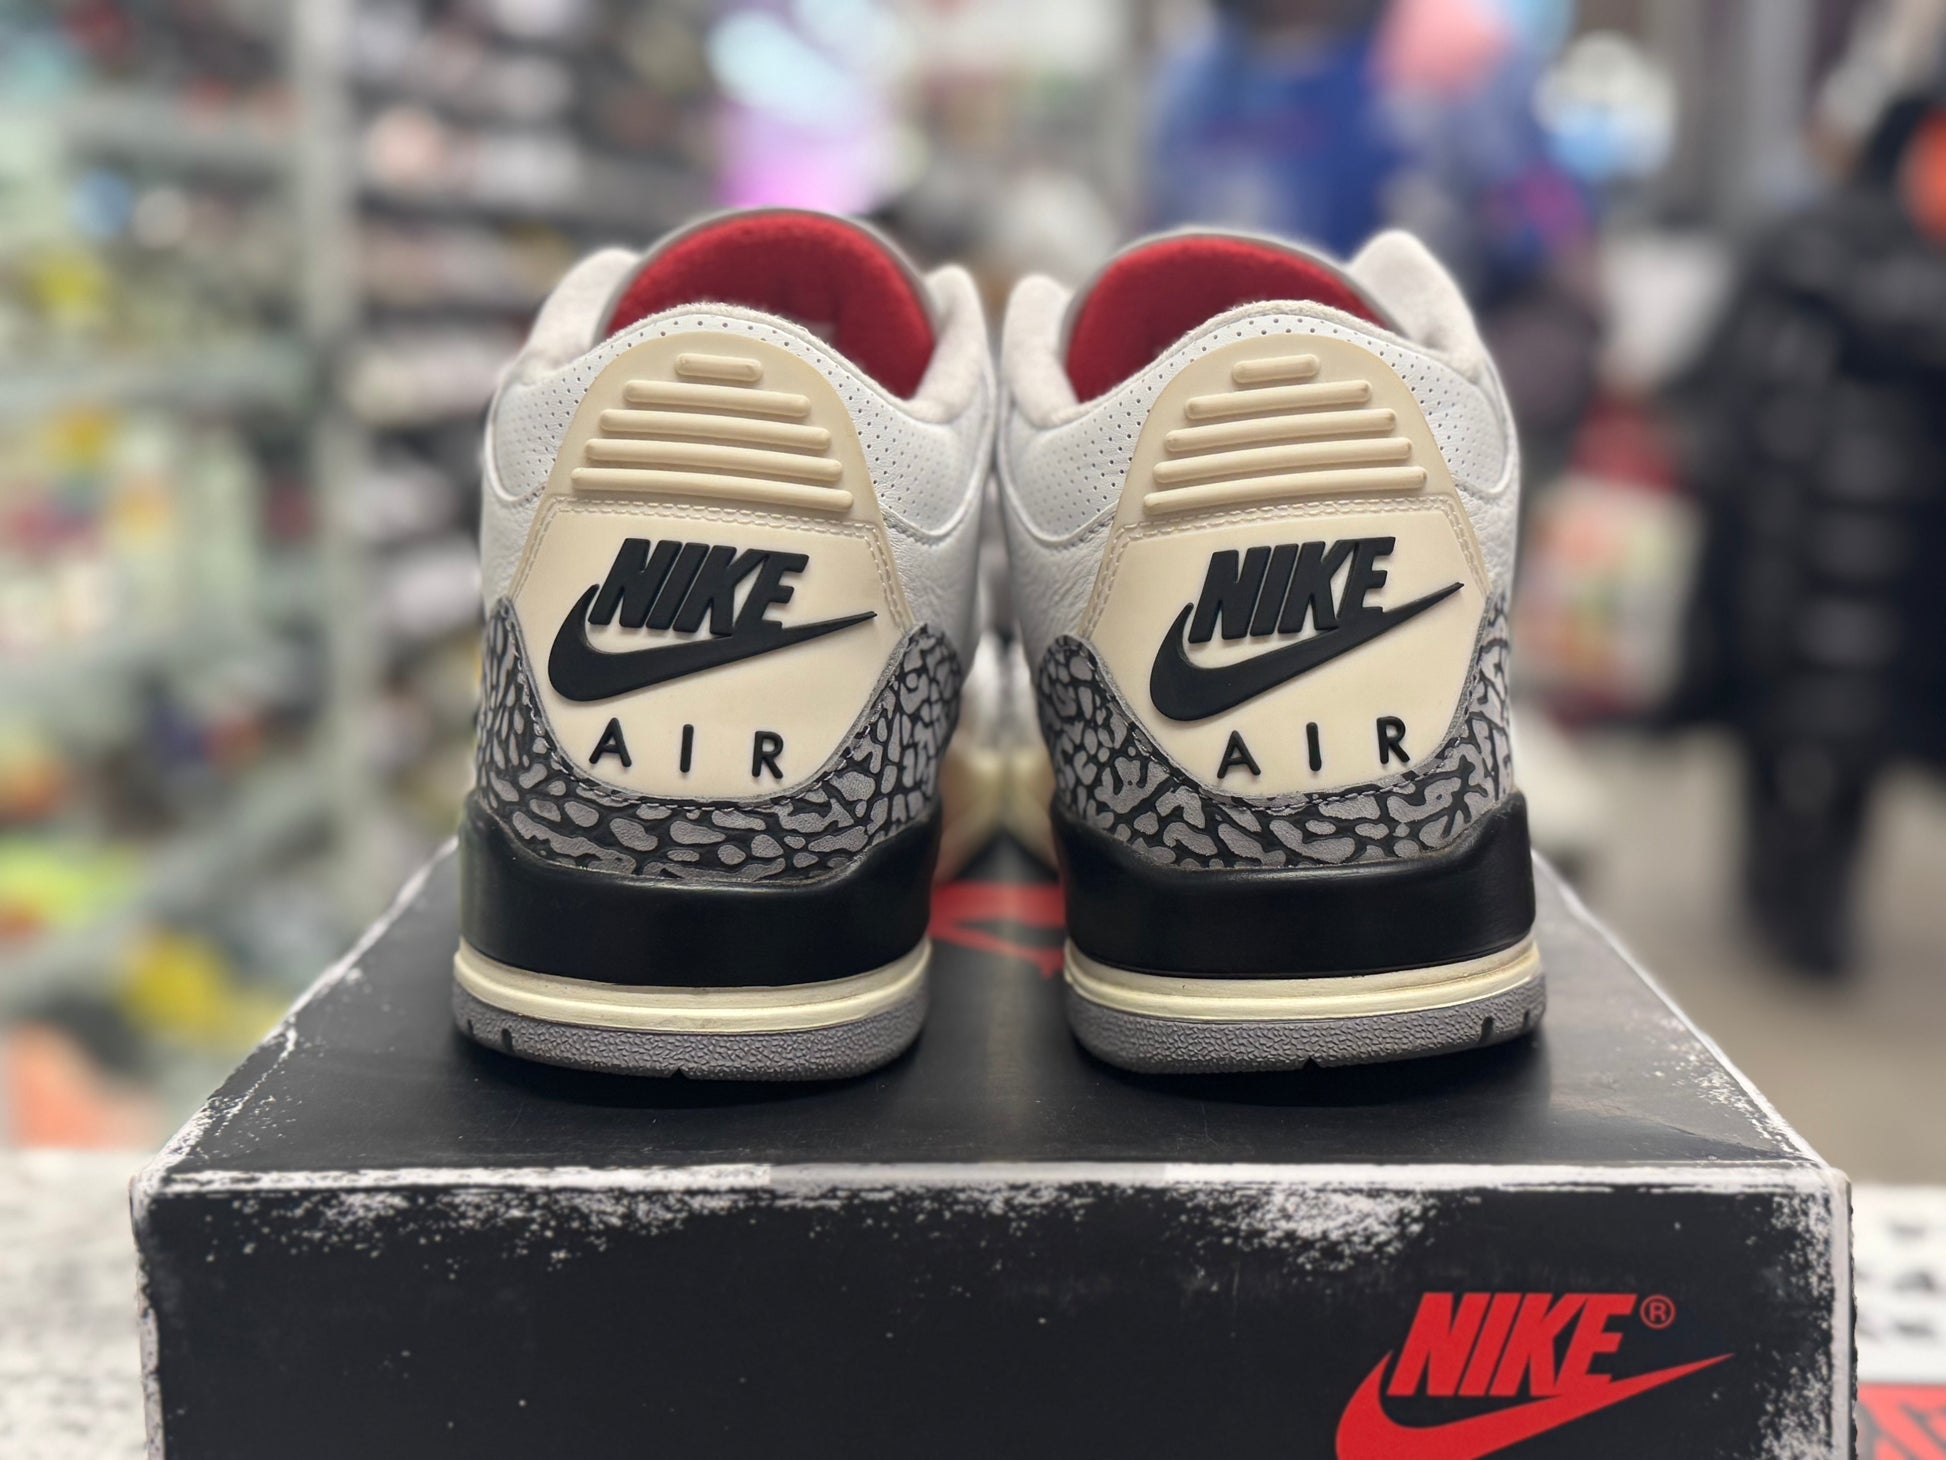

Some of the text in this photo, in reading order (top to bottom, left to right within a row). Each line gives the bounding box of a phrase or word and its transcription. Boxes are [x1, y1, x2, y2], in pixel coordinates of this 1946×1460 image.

[588, 537, 810, 637] NIKE
[1188, 536, 1396, 644] NIKE
[588, 717, 784, 780] AIR
[1216, 716, 1411, 779] AIR
[1386, 1292, 1637, 1397] NIKE
